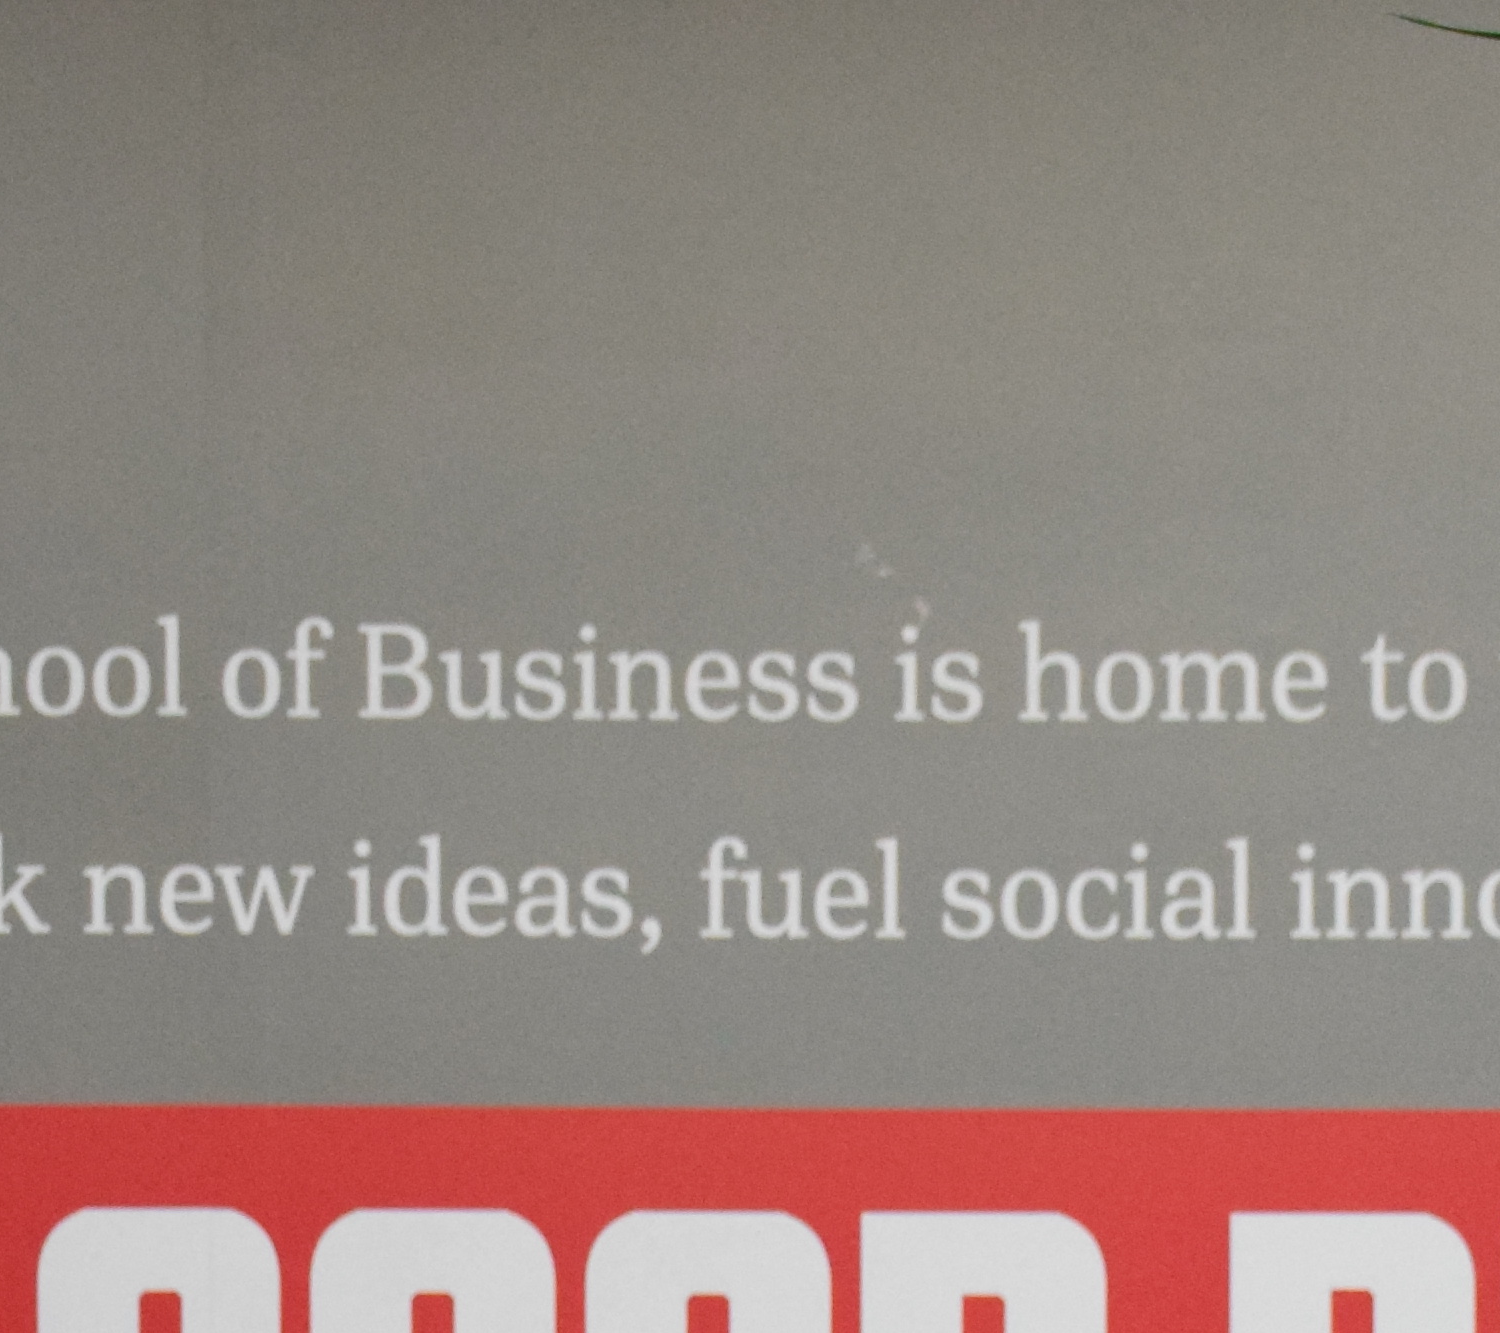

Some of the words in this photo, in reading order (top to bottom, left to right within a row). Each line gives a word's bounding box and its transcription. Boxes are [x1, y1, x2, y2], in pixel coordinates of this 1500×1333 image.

[222, 616, 334, 719] of
[358, 623, 859, 723] Business
[894, 625, 983, 722] is
[1018, 620, 1328, 722] home
[1360, 634, 1468, 722] to
[83, 863, 315, 936] new
[346, 833, 663, 955] ideas,
[700, 835, 906, 940] fuel
[942, 837, 1255, 940] social
